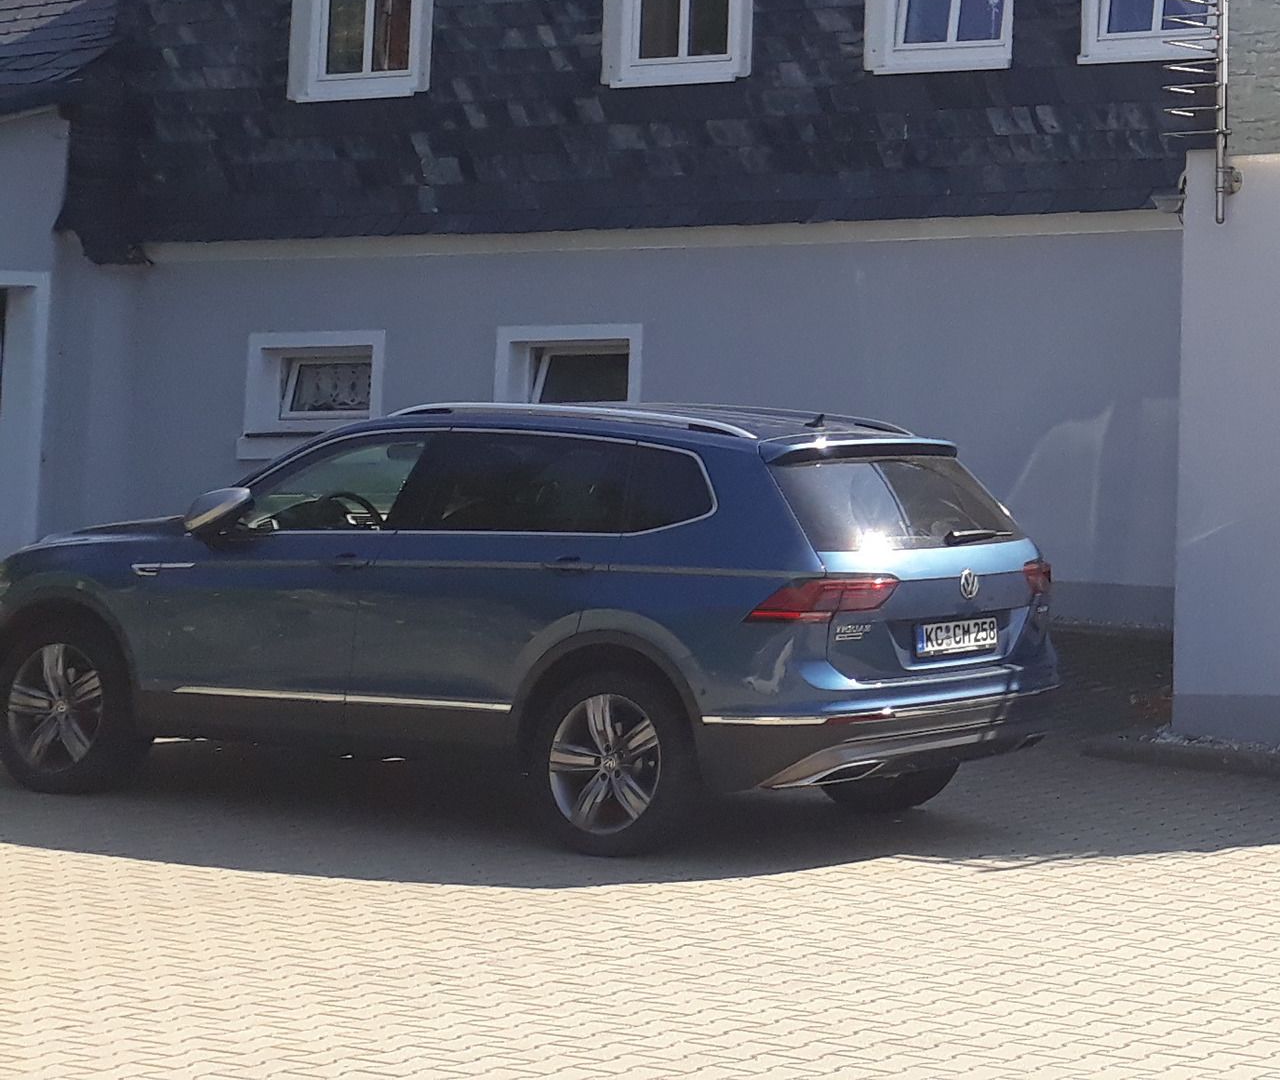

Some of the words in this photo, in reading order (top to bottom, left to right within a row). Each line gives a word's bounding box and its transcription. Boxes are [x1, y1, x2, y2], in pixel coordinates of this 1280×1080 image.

[925, 624, 944, 648] KC
[952, 623, 972, 645] CM
[973, 620, 997, 642] 258
